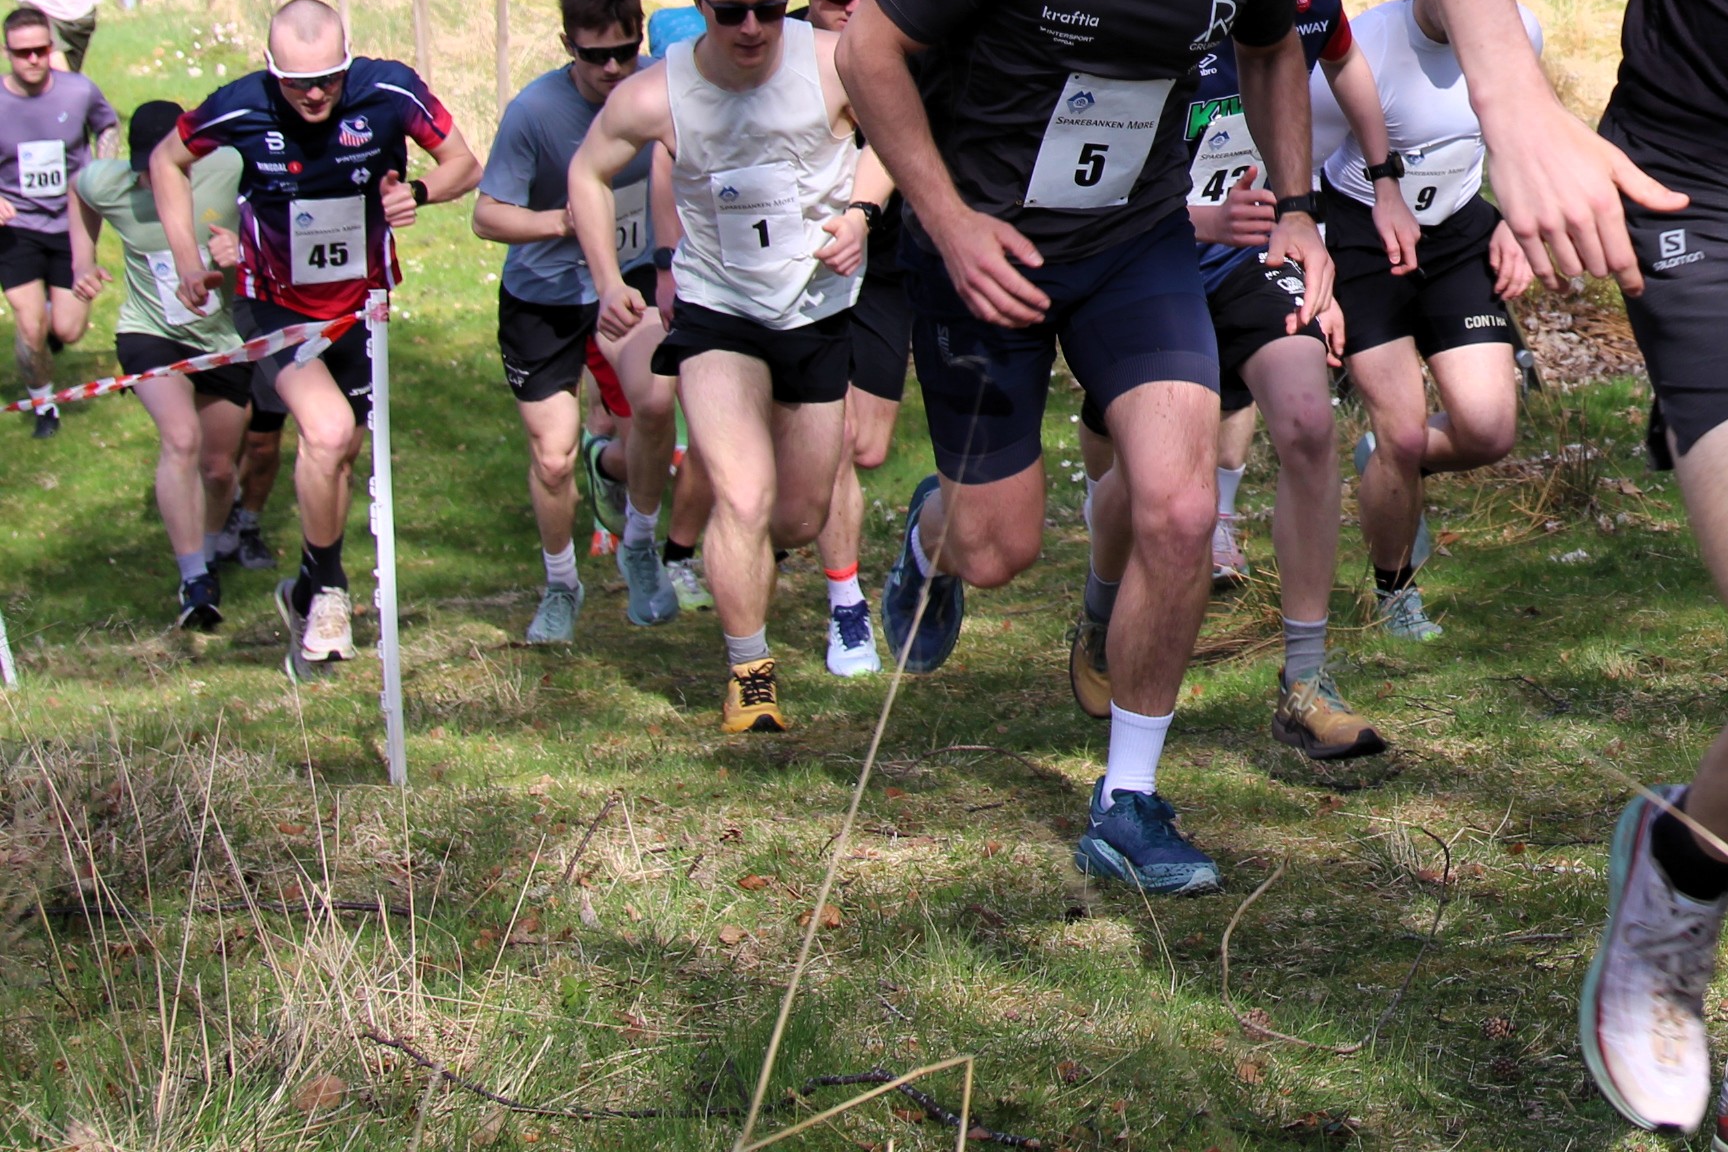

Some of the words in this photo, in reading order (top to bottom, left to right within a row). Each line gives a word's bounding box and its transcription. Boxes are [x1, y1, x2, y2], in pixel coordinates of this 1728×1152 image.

[1042, 5, 1099, 27] kraftia
[1046, 29, 1094, 42] INTERSPORT
[1056, 116, 1124, 129] SPAREBANKEN
[1126, 120, 1155, 130] MØRE
[1074, 142, 1109, 187] 5
[24, 170, 61, 189] 200
[1414, 186, 1437, 212] 9
[752, 219, 770, 248] 1
[308, 242, 349, 269] 45
